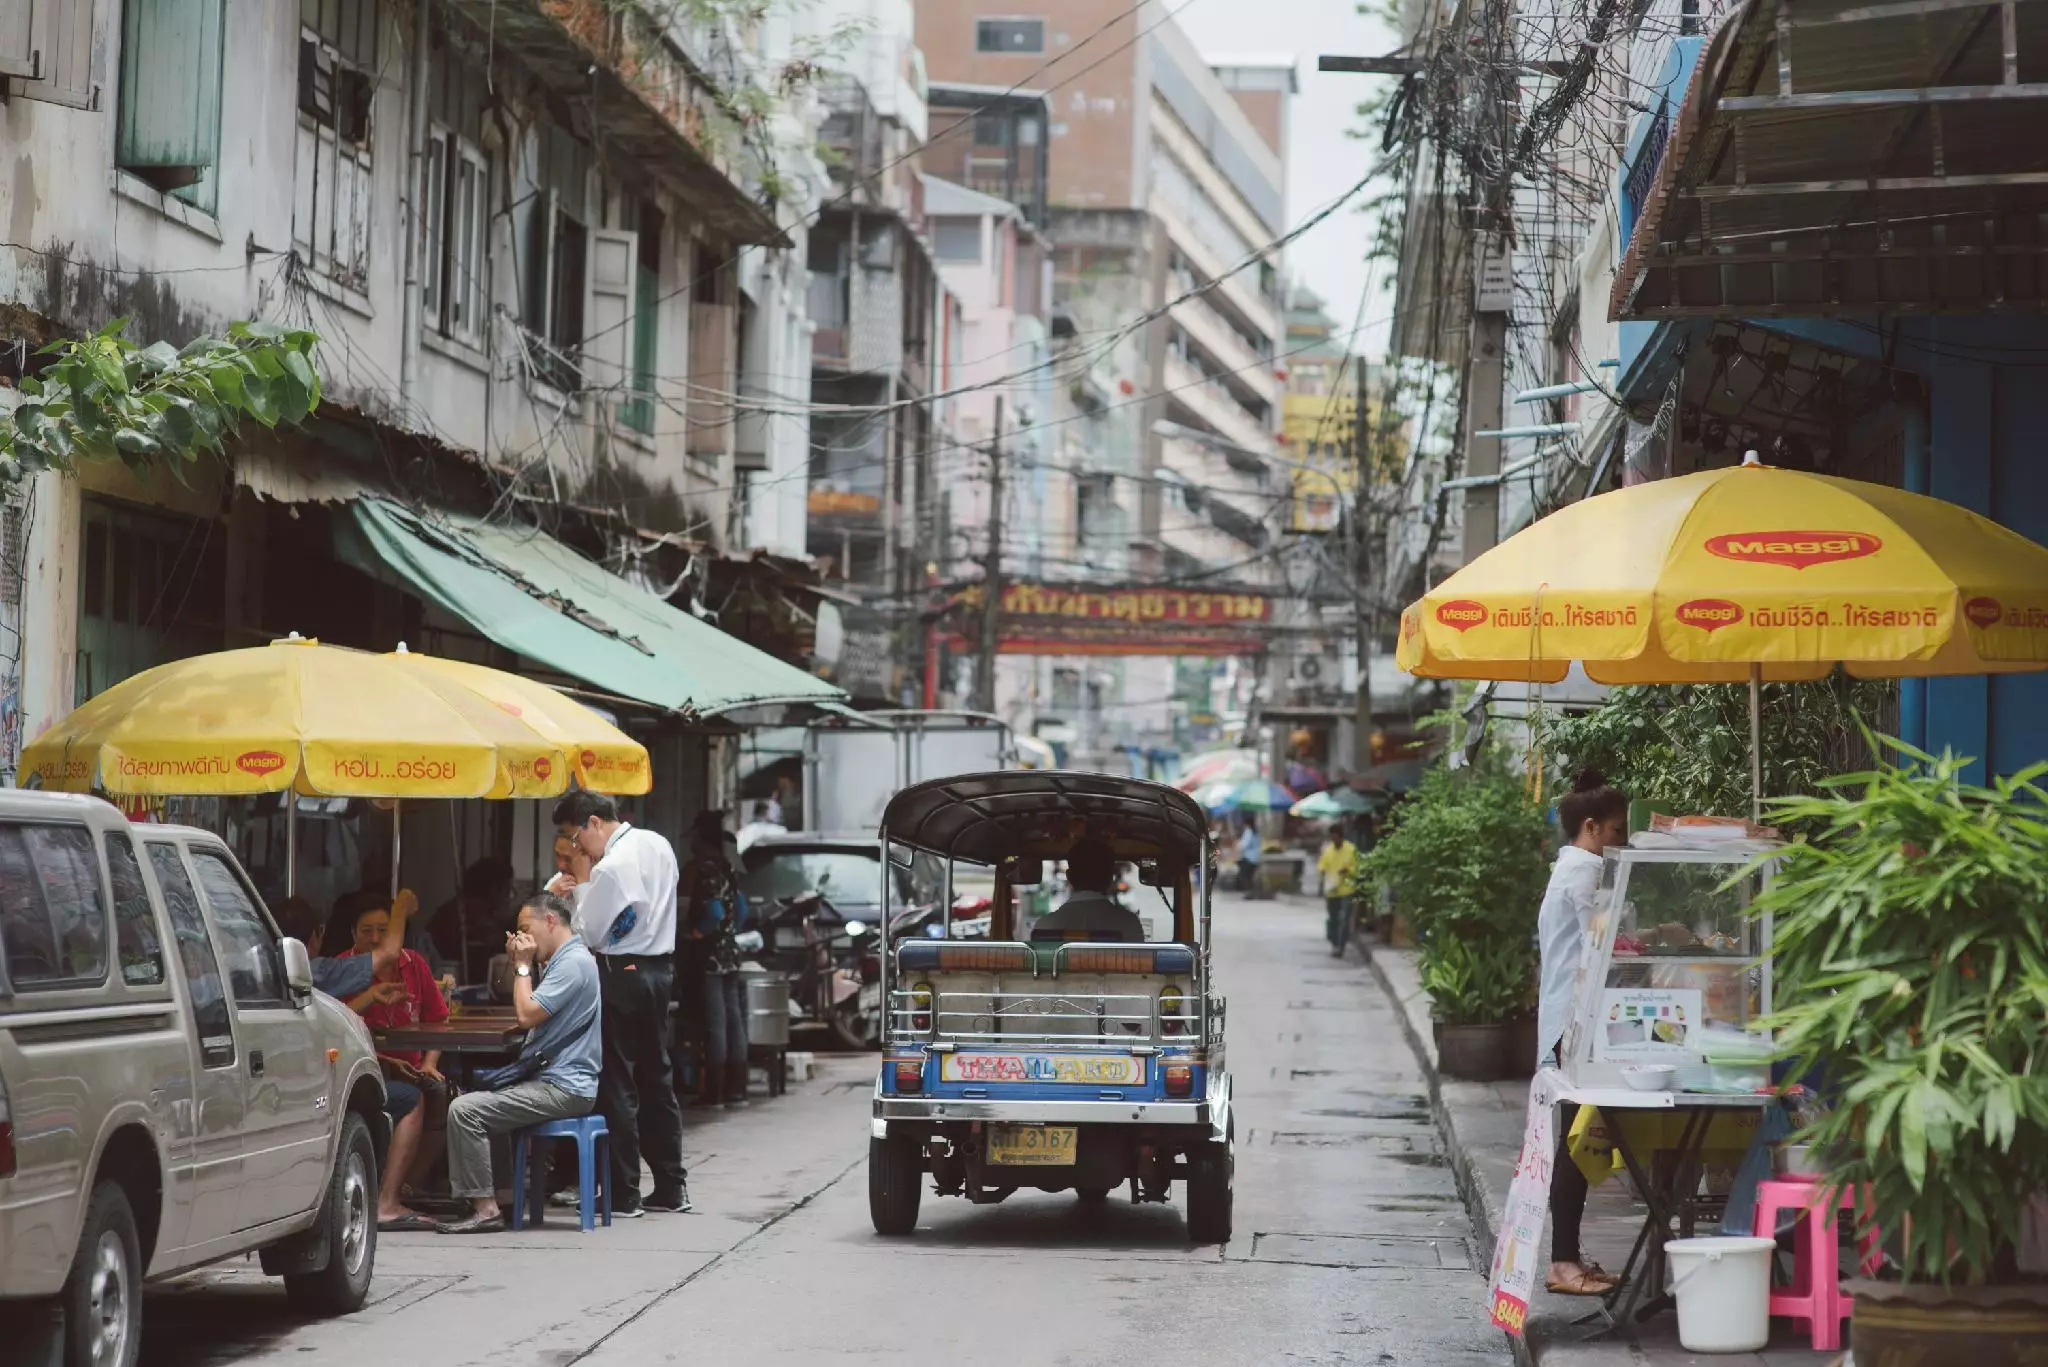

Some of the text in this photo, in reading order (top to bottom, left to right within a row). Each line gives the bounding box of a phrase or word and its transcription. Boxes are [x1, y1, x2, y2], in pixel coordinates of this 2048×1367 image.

[1727, 537, 1861, 555] Maggi
[1442, 607, 1484, 622] Maggi
[1682, 606, 1737, 621] Maggi
[242, 756, 281, 769] Maggi
[957, 1056, 1130, 1081] THAILAND
[1026, 1129, 1073, 1149] 3167
